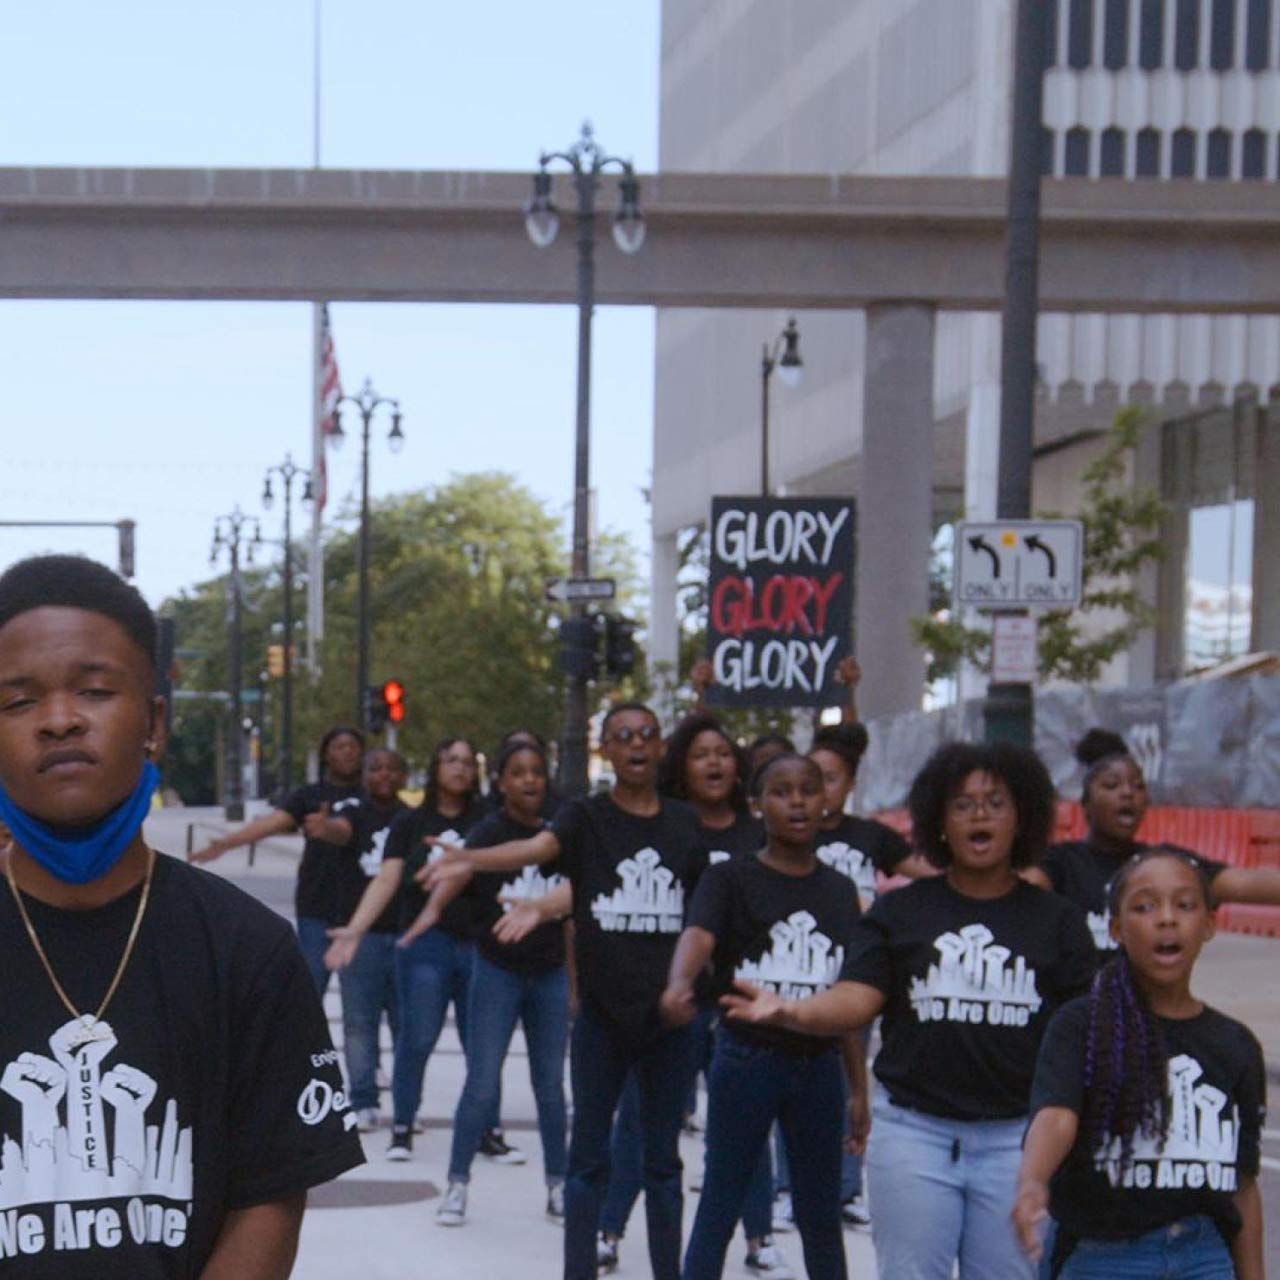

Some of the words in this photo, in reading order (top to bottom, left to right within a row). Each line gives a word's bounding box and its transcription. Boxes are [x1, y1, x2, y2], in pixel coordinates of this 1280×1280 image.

[715, 507, 849, 570] GLORY
[711, 572, 843, 638] GLORY
[713, 636, 838, 692] GLORY
[947, 998, 985, 1024] Are
[79, 1052, 97, 1169] JUSTICE
[1156, 1157, 1205, 1190] Are
[54, 1202, 123, 1251] Are
